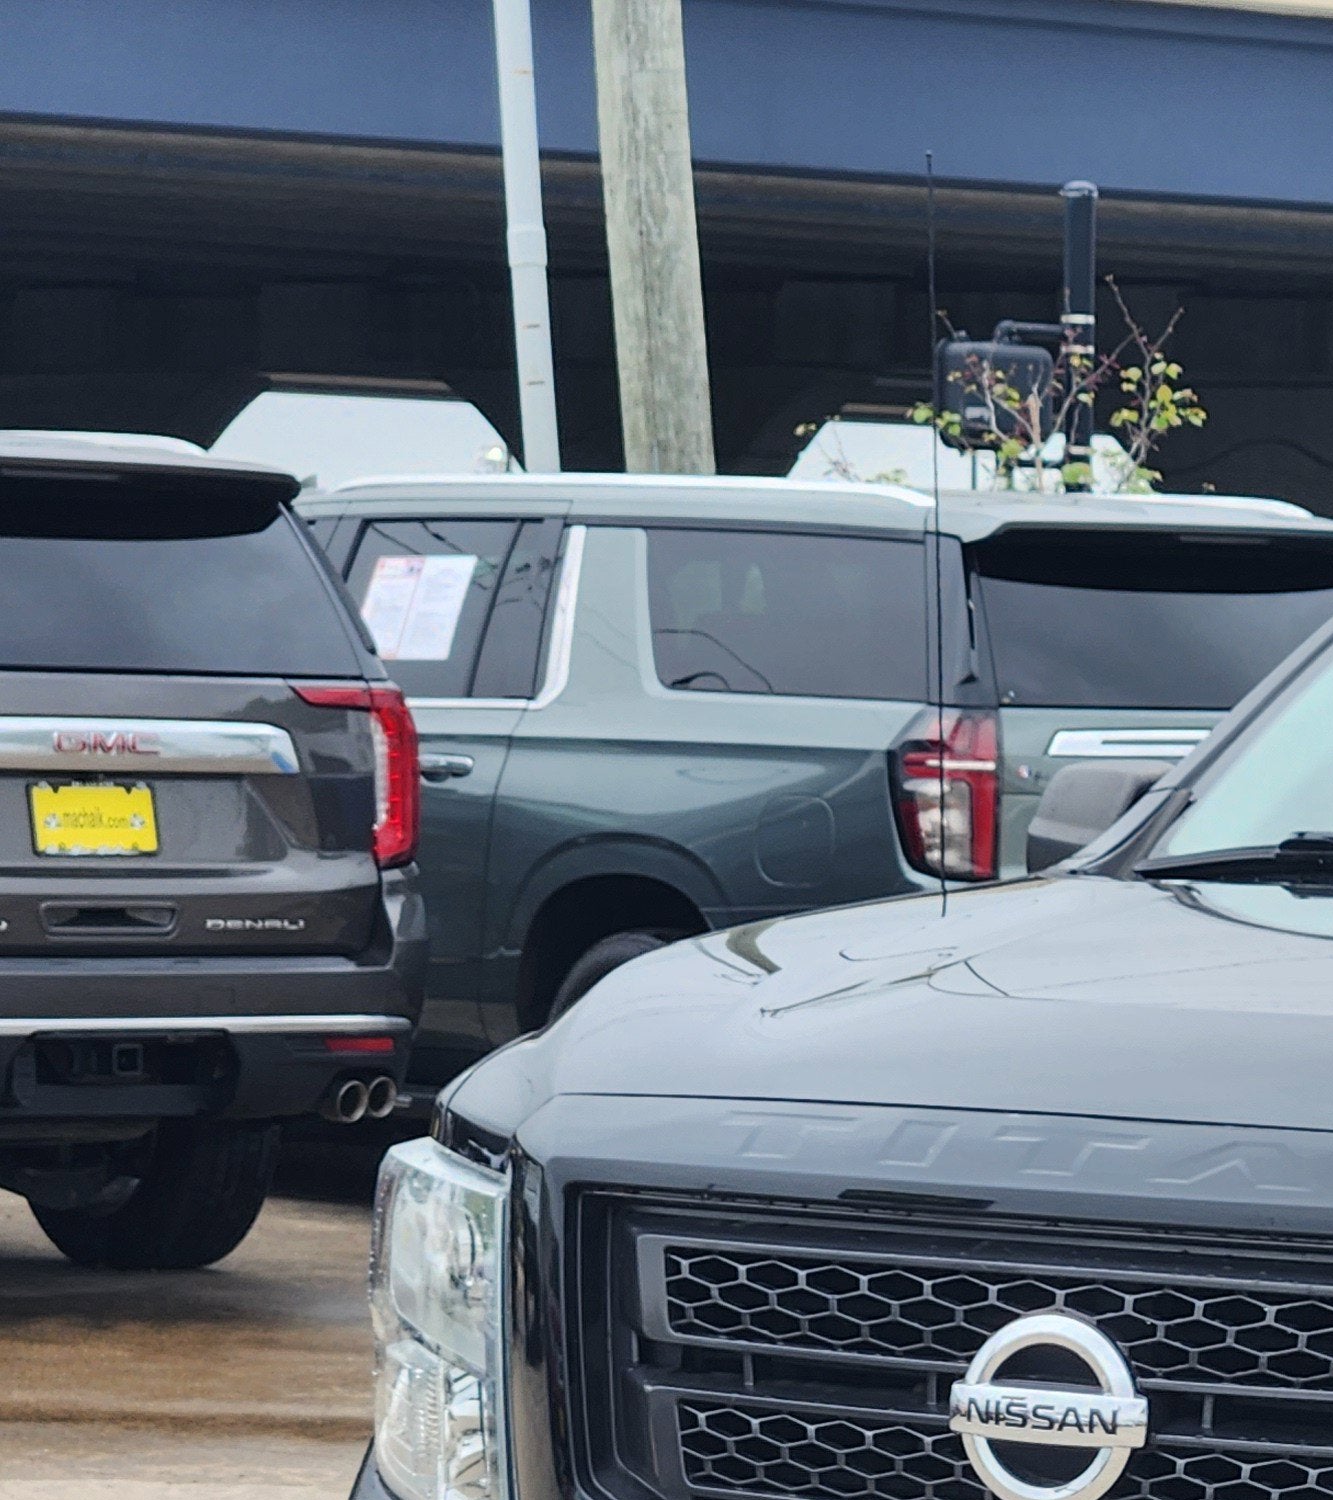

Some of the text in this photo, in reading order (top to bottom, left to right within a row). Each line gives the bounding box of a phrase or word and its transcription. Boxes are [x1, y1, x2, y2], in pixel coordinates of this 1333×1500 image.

[54, 731, 160, 755] GMC
[205, 918, 304, 930] DENALI
[966, 1397, 1119, 1436] NISSAN
